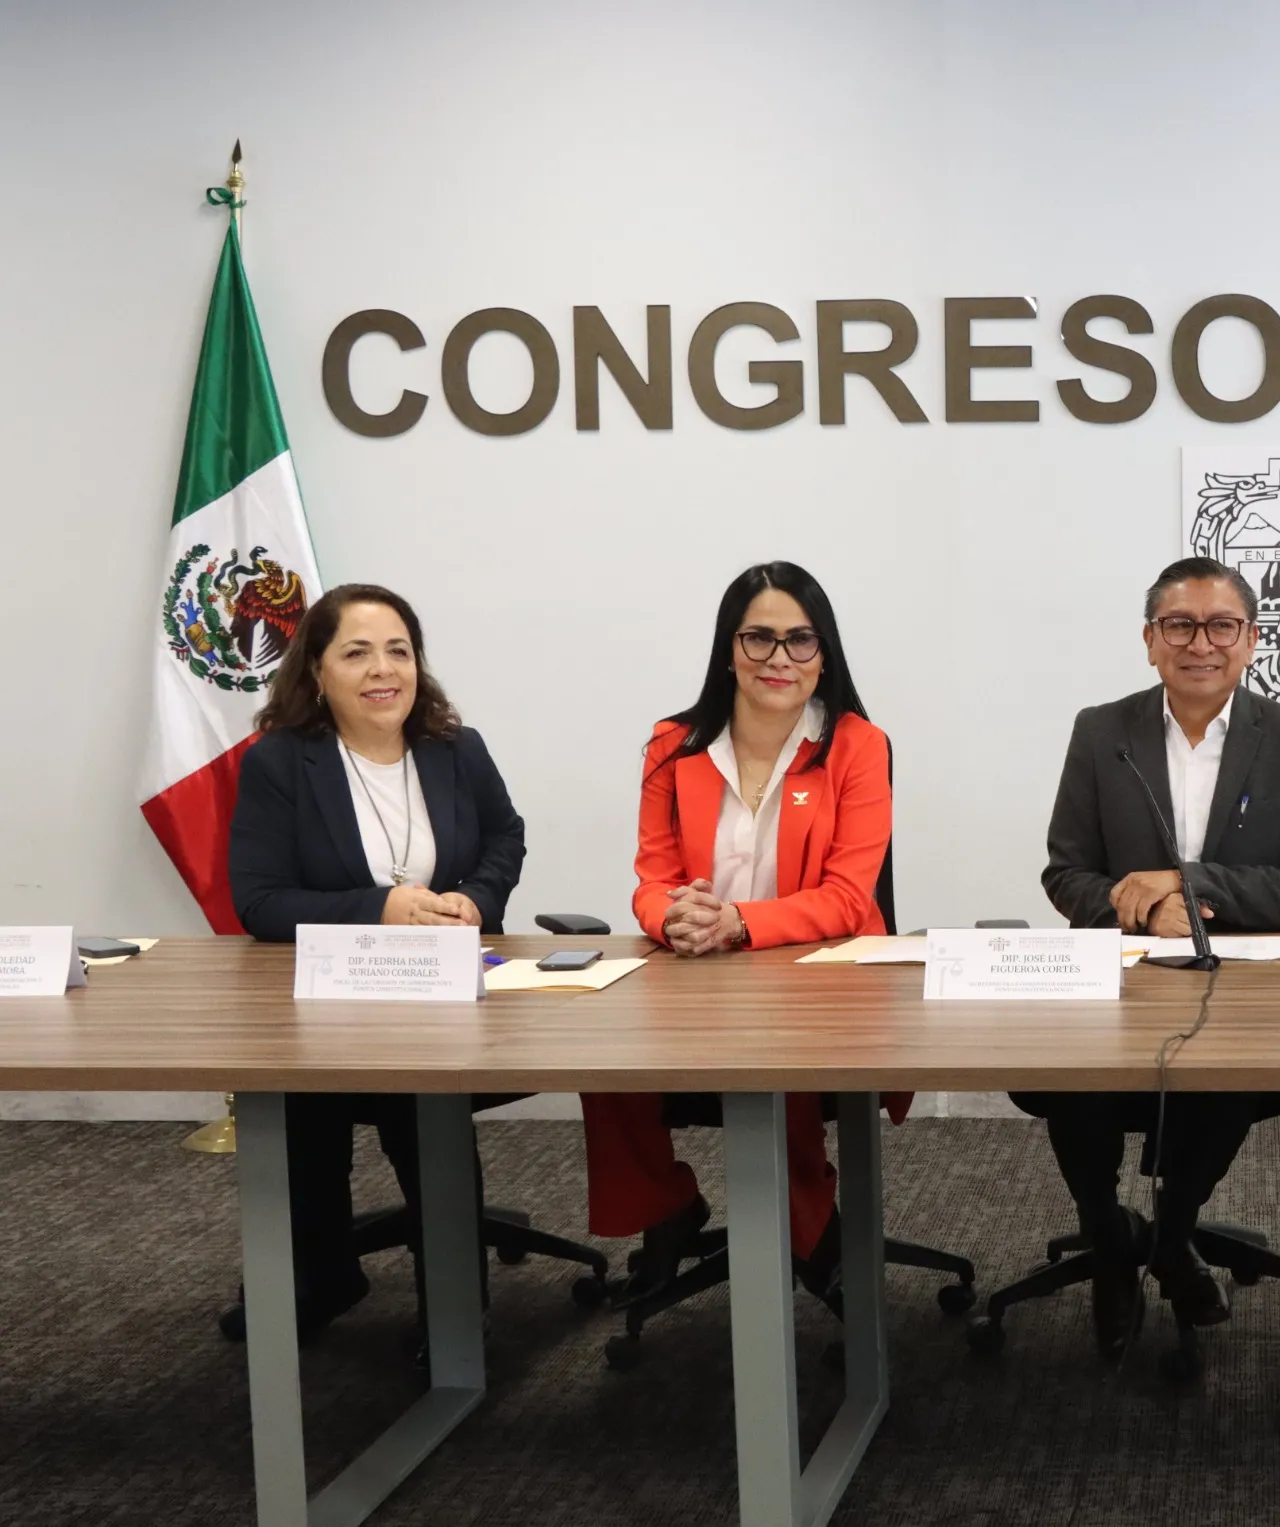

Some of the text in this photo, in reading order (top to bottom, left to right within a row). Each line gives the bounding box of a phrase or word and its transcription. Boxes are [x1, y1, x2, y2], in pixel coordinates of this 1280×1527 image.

[1245, 550, 1265, 560] EN
[368, 957, 406, 966] FEDRHA
[408, 957, 441, 967] ISABEL
[1001, 953, 1071, 964] DIP. JOSÉ LUIS
[348, 968, 440, 977] SURIANO CORRALES
[990, 963, 1081, 974] FIGUEROA CORTÉS
